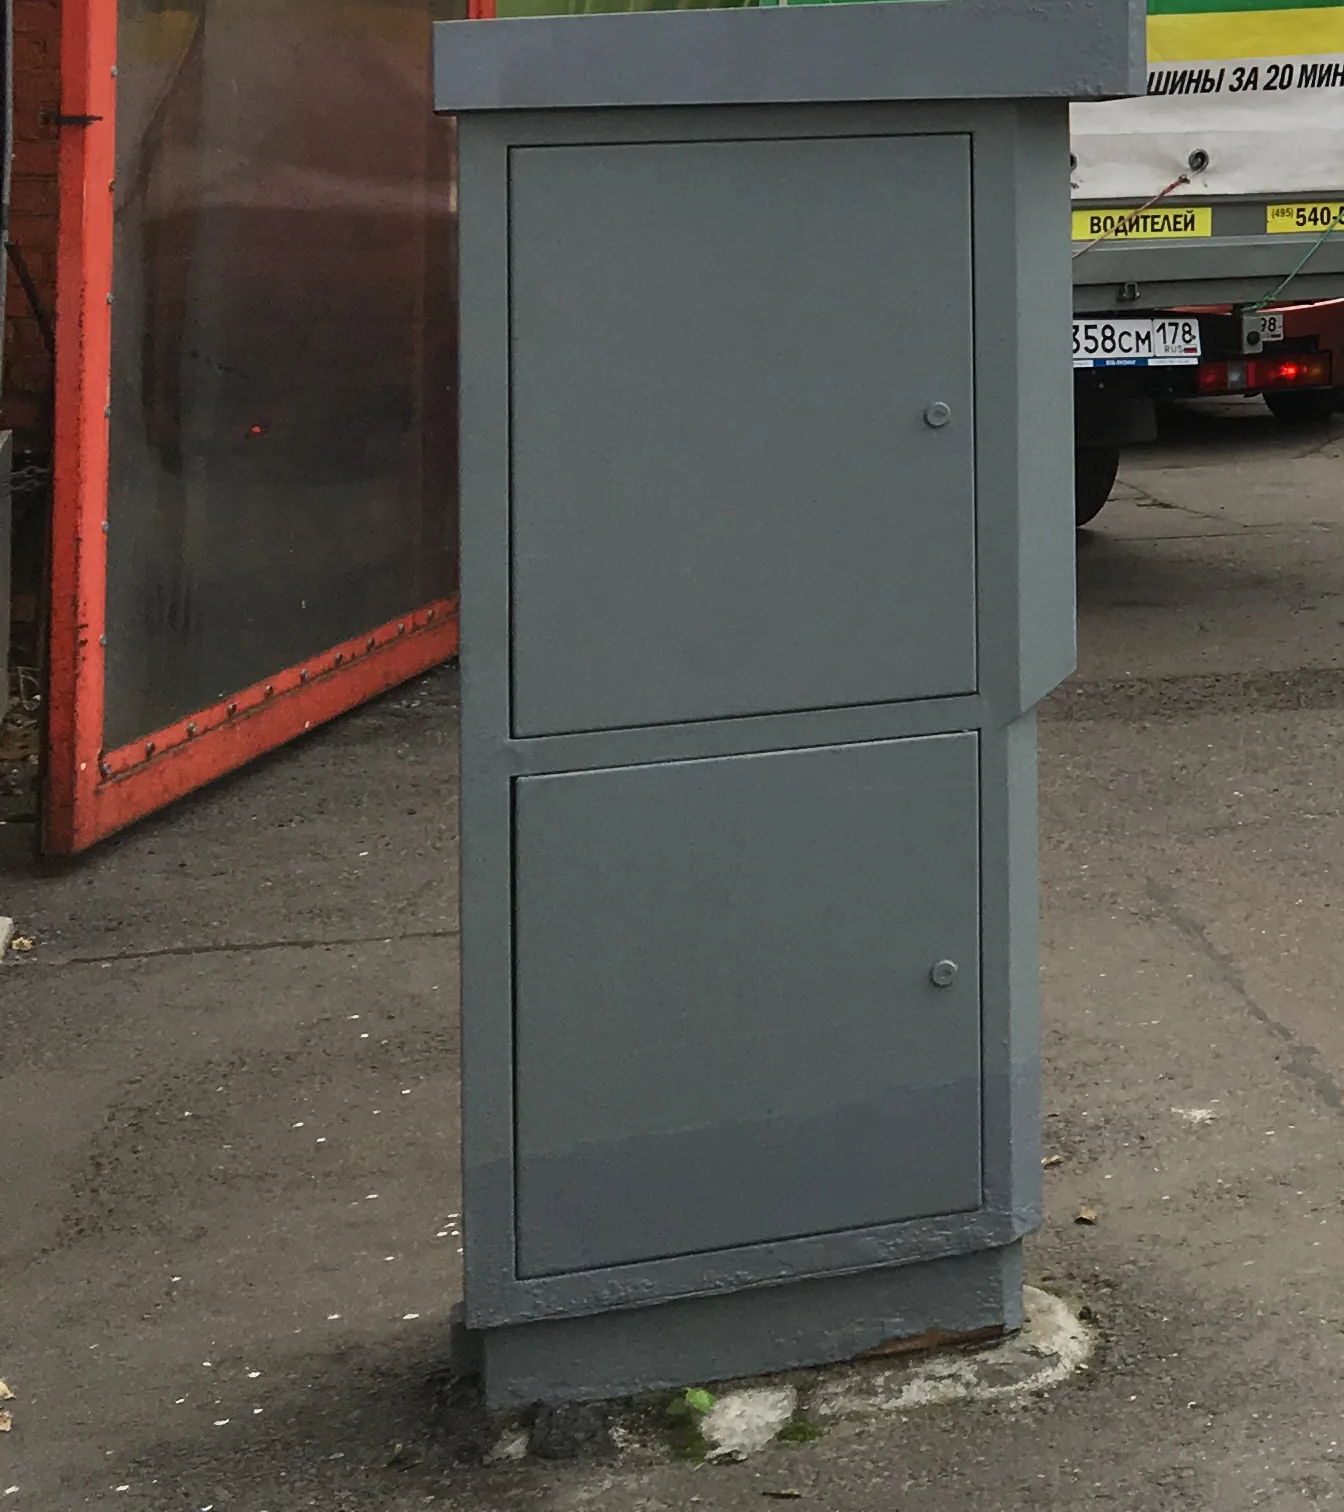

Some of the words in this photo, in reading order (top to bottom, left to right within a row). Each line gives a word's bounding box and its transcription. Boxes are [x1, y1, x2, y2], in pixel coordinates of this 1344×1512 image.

[1147, 68, 1225, 96] ШИНЫ
[1228, 66, 1258, 93] ЗА
[1263, 64, 1294, 91] 20
[1090, 210, 1195, 236] ВОДИТЕЛЕЙ
[1271, 207, 1294, 220] (495)
[1156, 322, 1193, 345] 178
[1164, 344, 1184, 354] RUS
